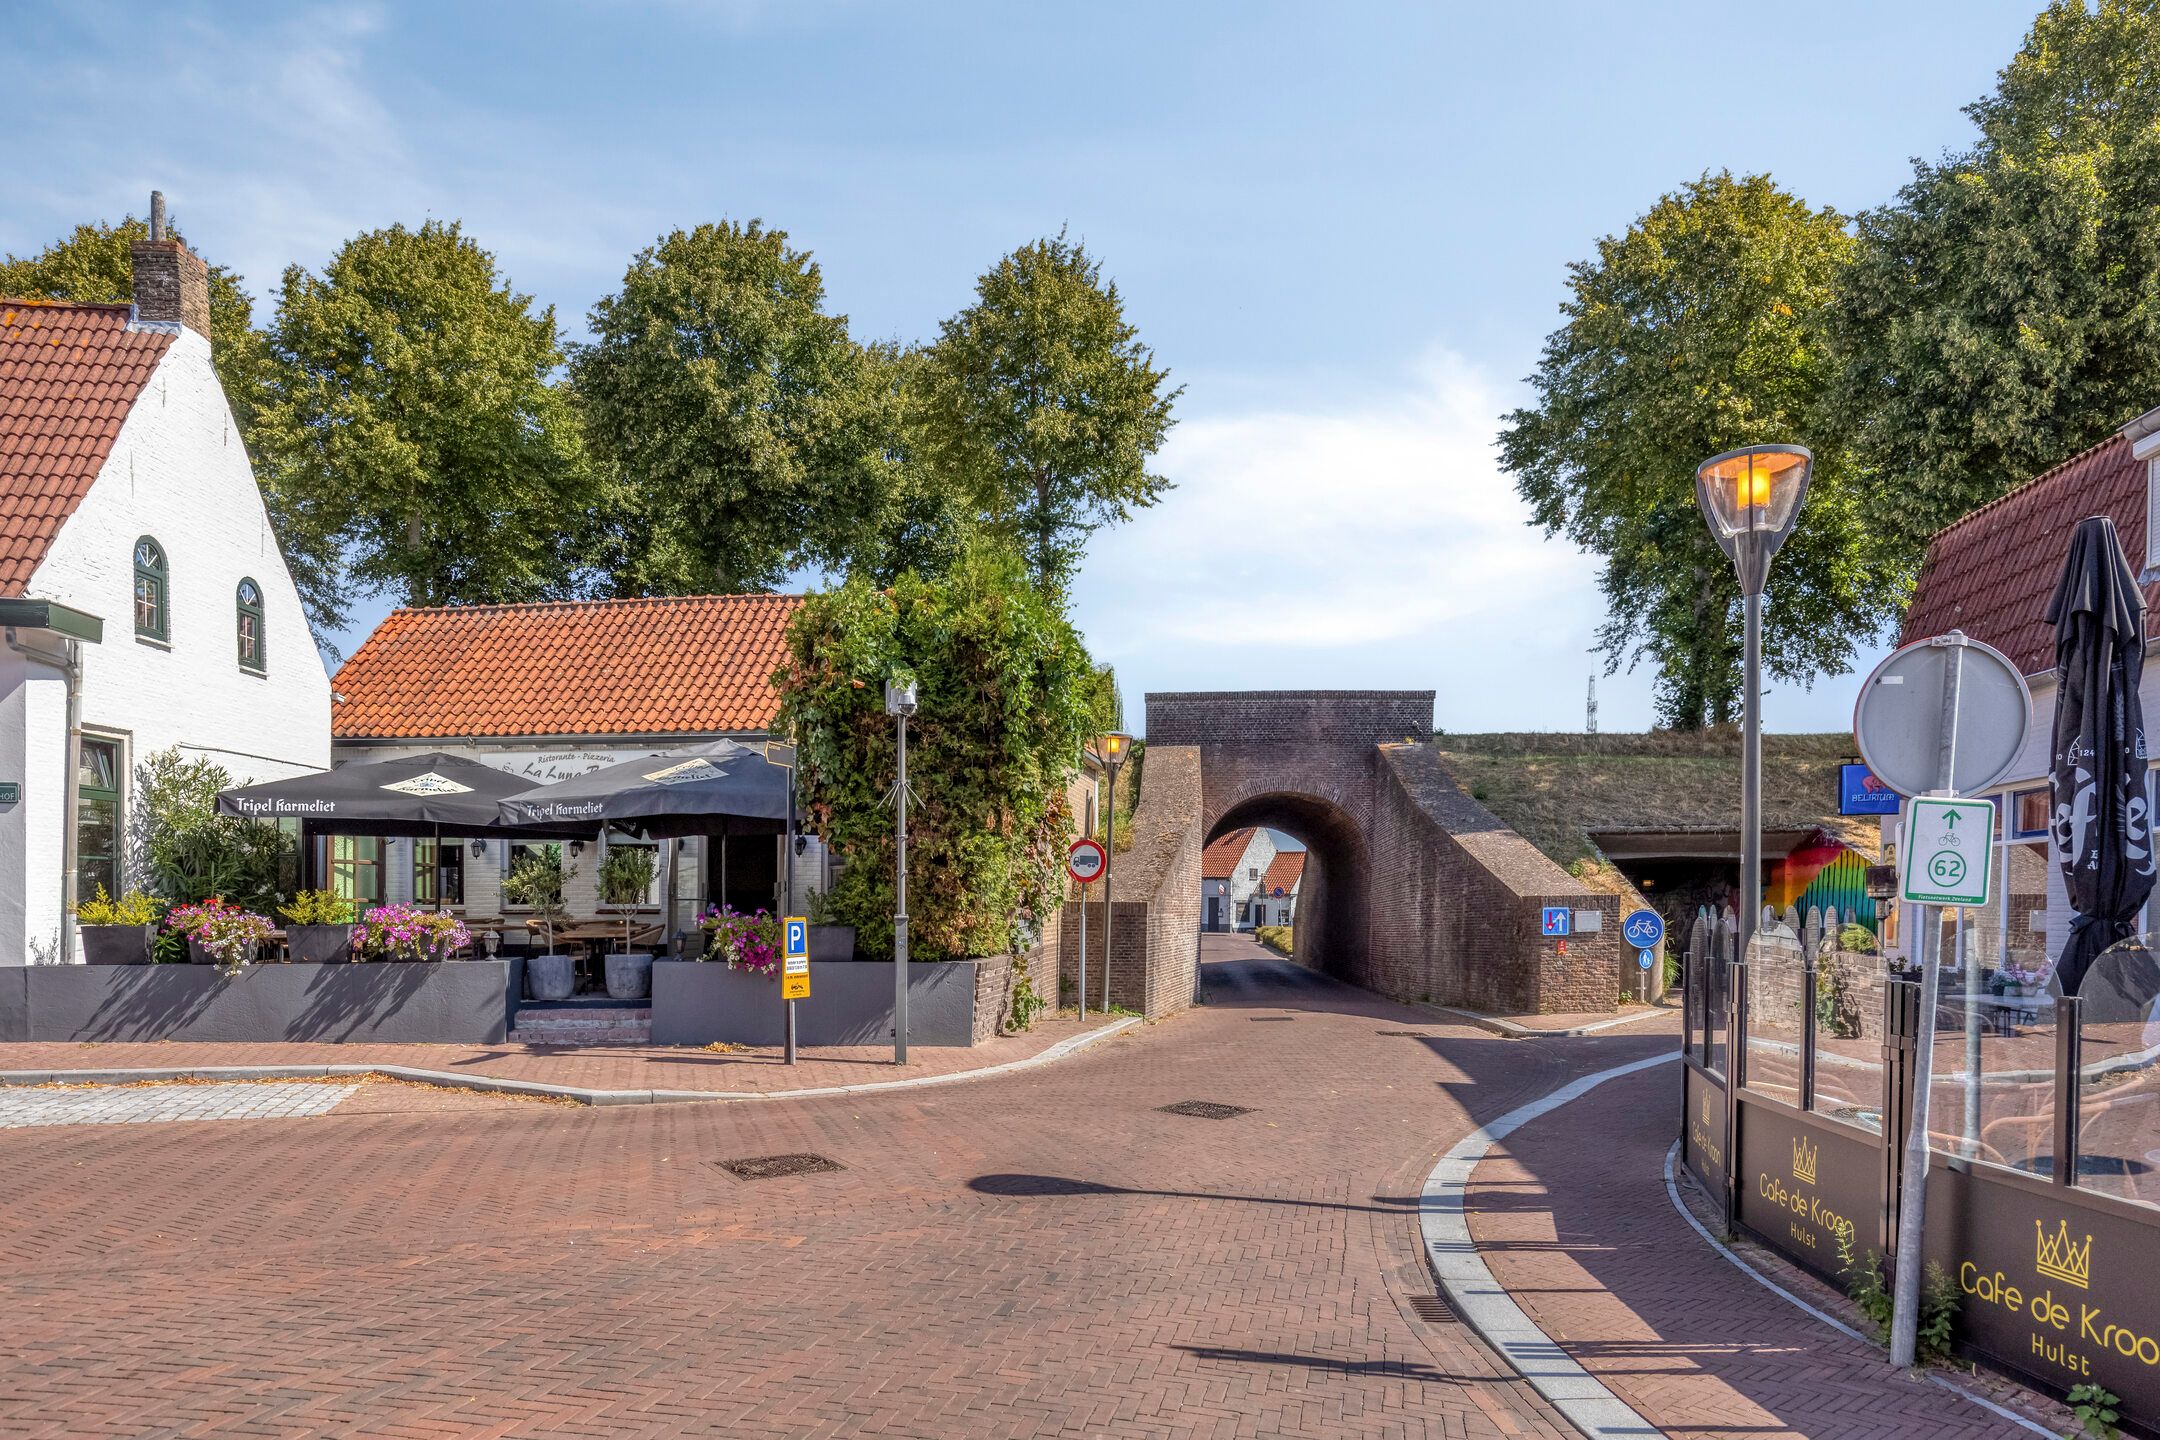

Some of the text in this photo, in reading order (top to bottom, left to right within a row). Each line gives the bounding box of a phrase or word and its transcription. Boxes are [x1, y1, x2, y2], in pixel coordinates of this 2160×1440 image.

[538, 753, 575, 763] Ristorante
[583, 753, 615, 763] Pizzeria
[2080, 749, 2095, 757] 124
[523, 762, 541, 778] La
[236, 797, 336, 815] Tripel Karmeliet
[527, 801, 603, 819] Tripel Karmeliet
[1935, 859, 1961, 877] 62
[790, 925, 801, 951] P
[1760, 1172, 1855, 1242] Cafe de Kroon
[1791, 1221, 1816, 1249] Hulst
[1961, 1261, 2160, 1365] Cafe de Kroo
[2032, 1332, 2090, 1376] Hulst
